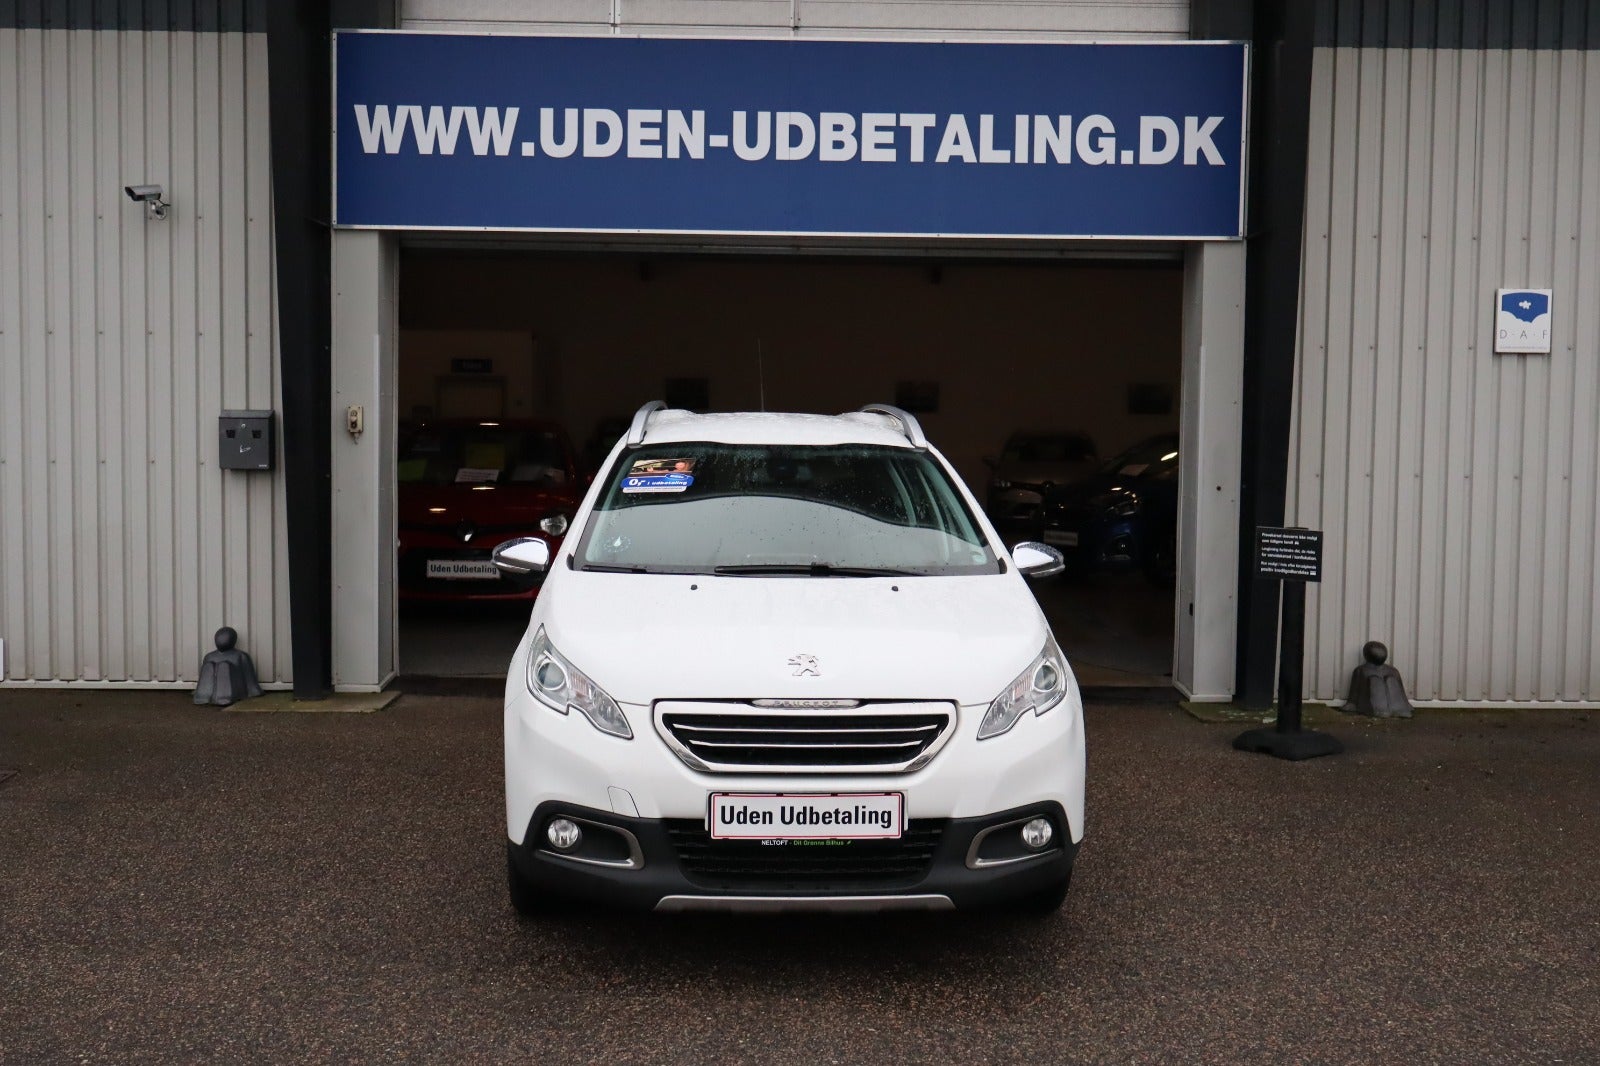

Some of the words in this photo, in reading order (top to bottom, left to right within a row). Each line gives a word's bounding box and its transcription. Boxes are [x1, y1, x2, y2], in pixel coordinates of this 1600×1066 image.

[354, 104, 1226, 166] WWW.UDEN-UDBETALING.DK
[430, 564, 451, 573] Uden
[453, 564, 497, 574] Udbetaling
[720, 806, 773, 825] Uden
[780, 806, 893, 829] Udbetaling
